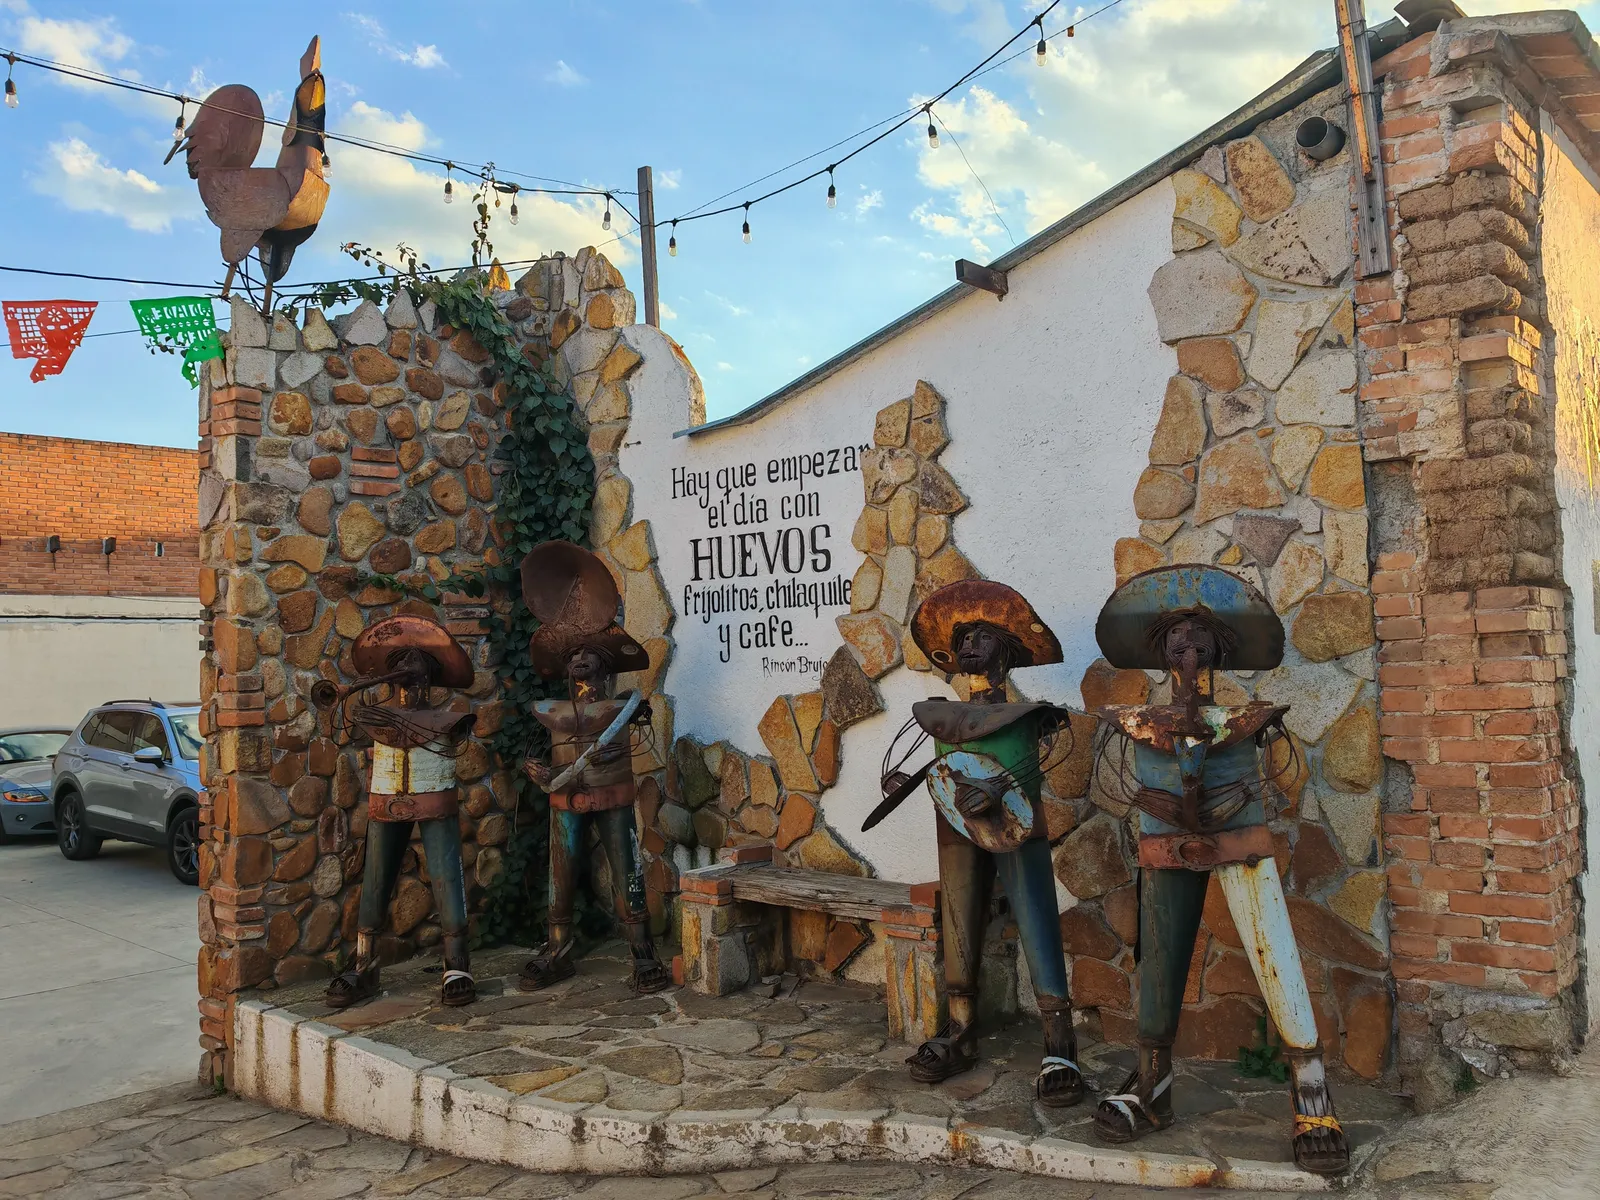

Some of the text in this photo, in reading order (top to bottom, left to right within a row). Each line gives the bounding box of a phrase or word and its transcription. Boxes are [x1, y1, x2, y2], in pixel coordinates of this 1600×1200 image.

[671, 467, 710, 509] Hay
[716, 462, 757, 505] que
[708, 491, 821, 529] el día con
[690, 524, 832, 581] HUEVOS
[684, 583, 765, 624] frijolitos,
[718, 625, 731, 662] y
[762, 657, 796, 678] Rincón
